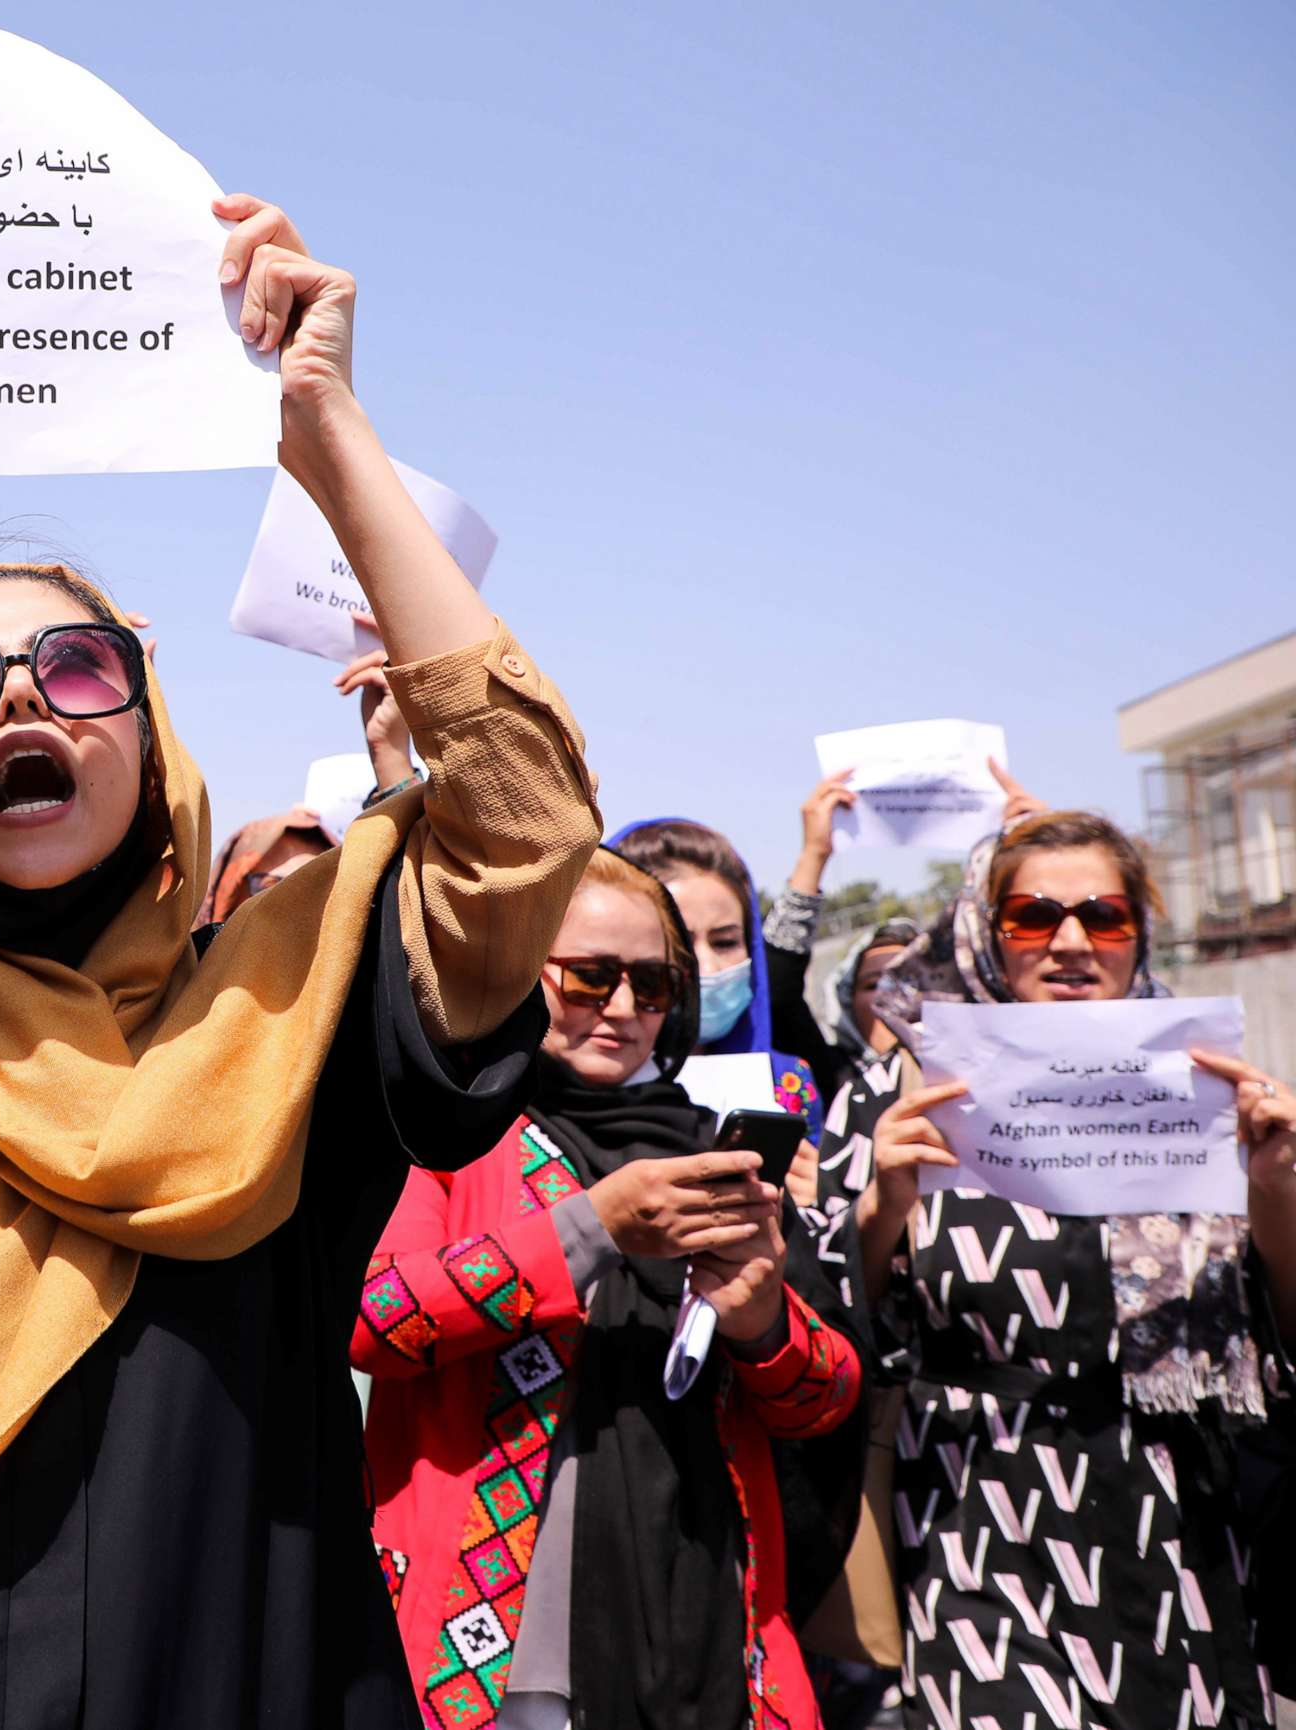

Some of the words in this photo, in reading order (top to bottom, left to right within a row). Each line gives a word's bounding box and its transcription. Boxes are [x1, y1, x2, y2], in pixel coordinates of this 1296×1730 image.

[35, 149, 111, 181] کابینه
[71, 204, 93, 236] با
[7, 261, 133, 291] cabinet
[139, 322, 175, 352] of
[296, 581, 324, 602] We
[989, 1121, 1060, 1140] Afghan
[1067, 1121, 1141, 1136] women
[1147, 1118, 1200, 1135] Earth
[976, 1149, 1013, 1168] The
[1020, 1152, 1091, 1171] symbol
[1097, 1150, 1117, 1168] of
[1123, 1150, 1157, 1168] this
[1165, 1149, 1208, 1166] land
